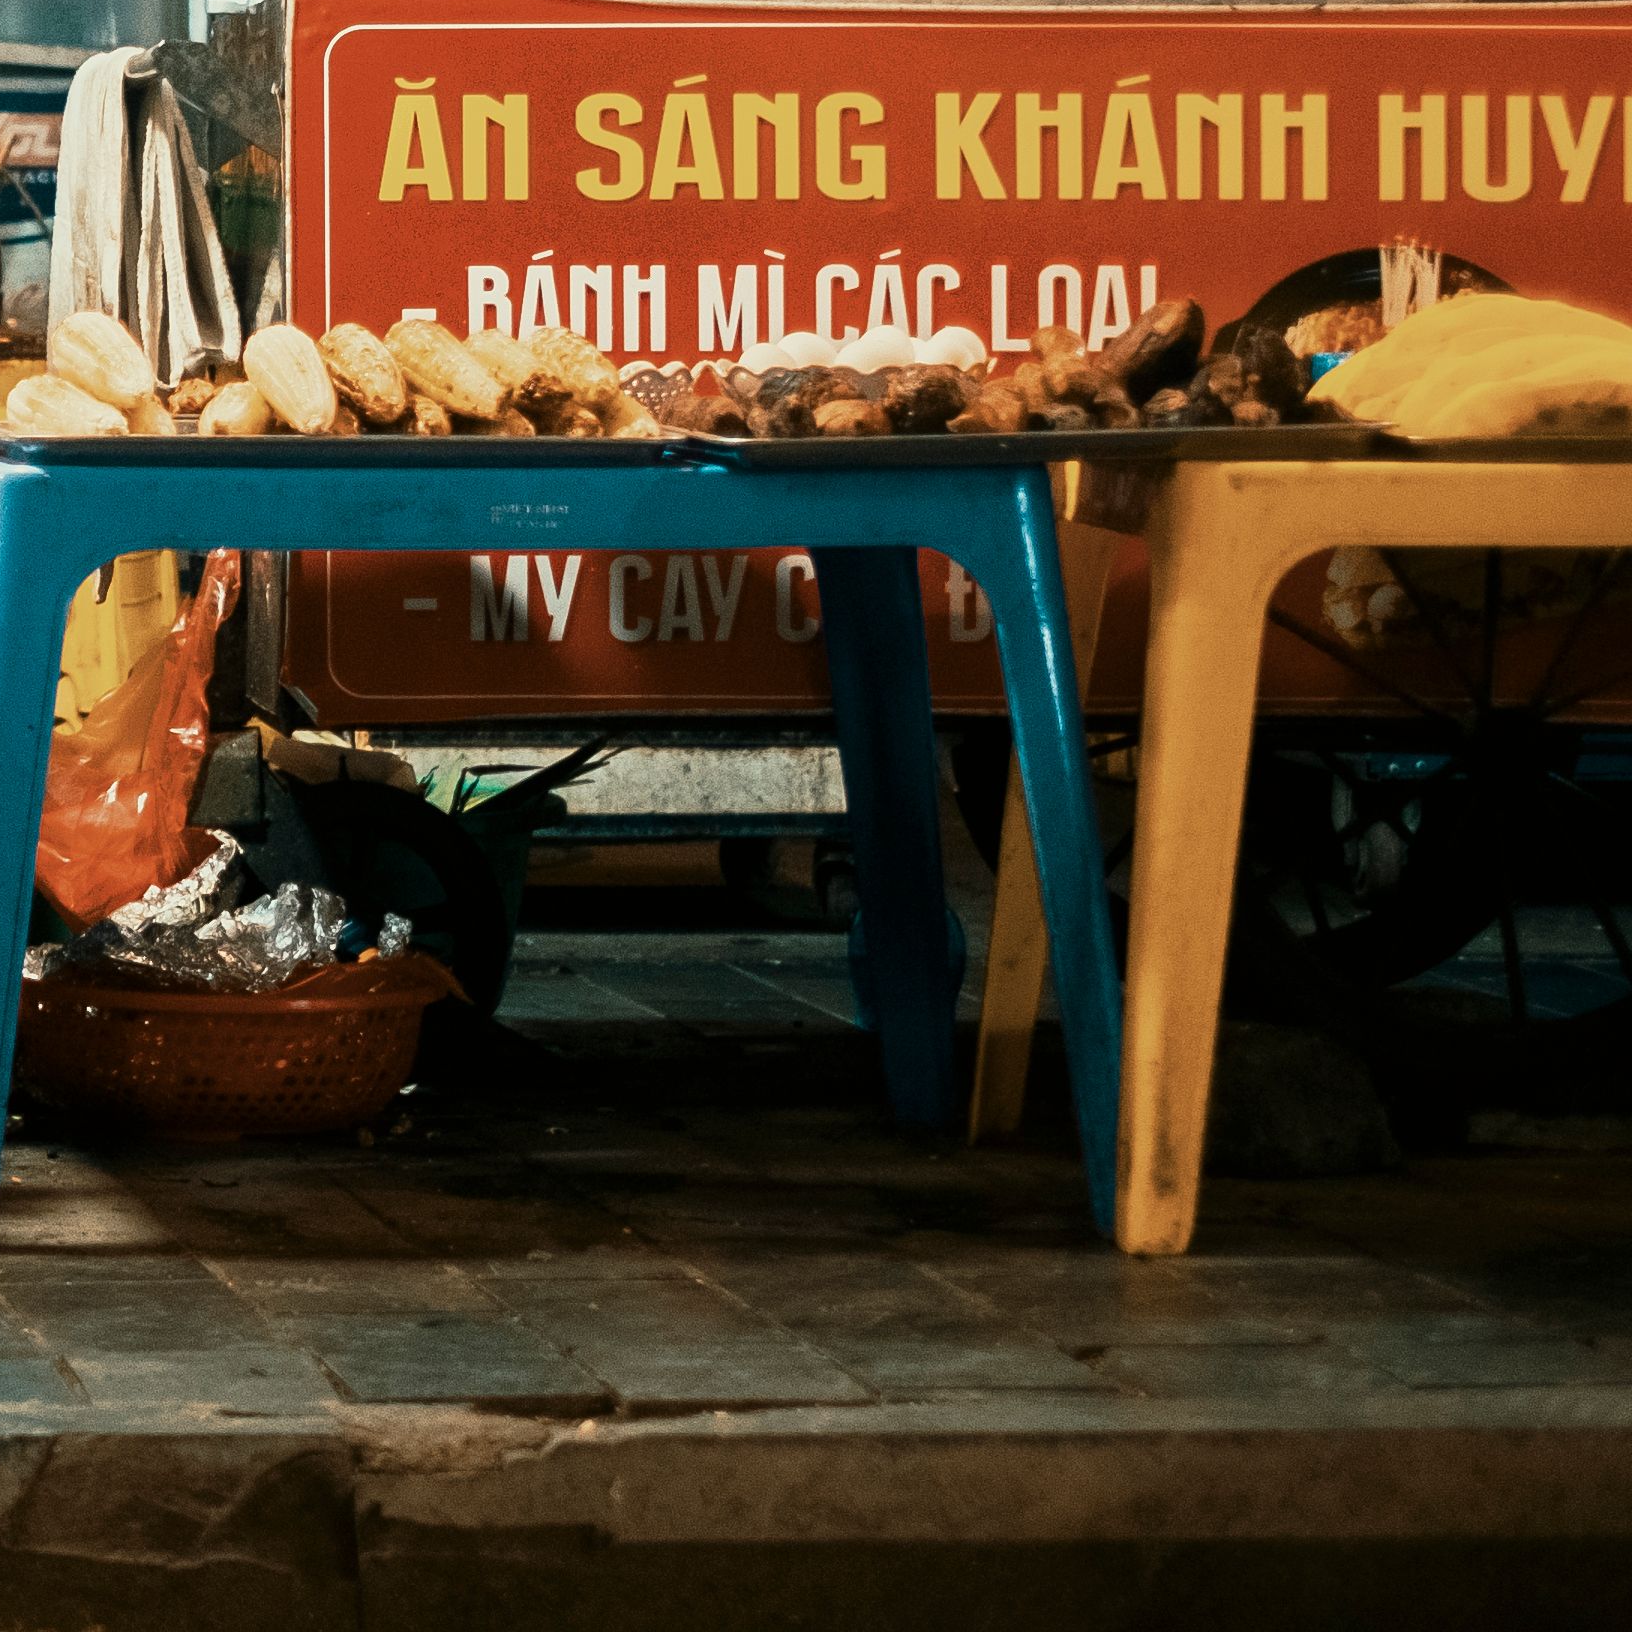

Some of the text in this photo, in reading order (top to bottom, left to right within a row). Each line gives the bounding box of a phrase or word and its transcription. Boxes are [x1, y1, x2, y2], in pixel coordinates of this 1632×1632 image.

[377, 73, 1632, 203] ĂN SÁNG KHÁNH HUY
[466, 249, 667, 353] BÁNH
[697, 247, 785, 352] MÌ
[815, 248, 961, 343] CÁC
[608, 554, 750, 643] CAY
